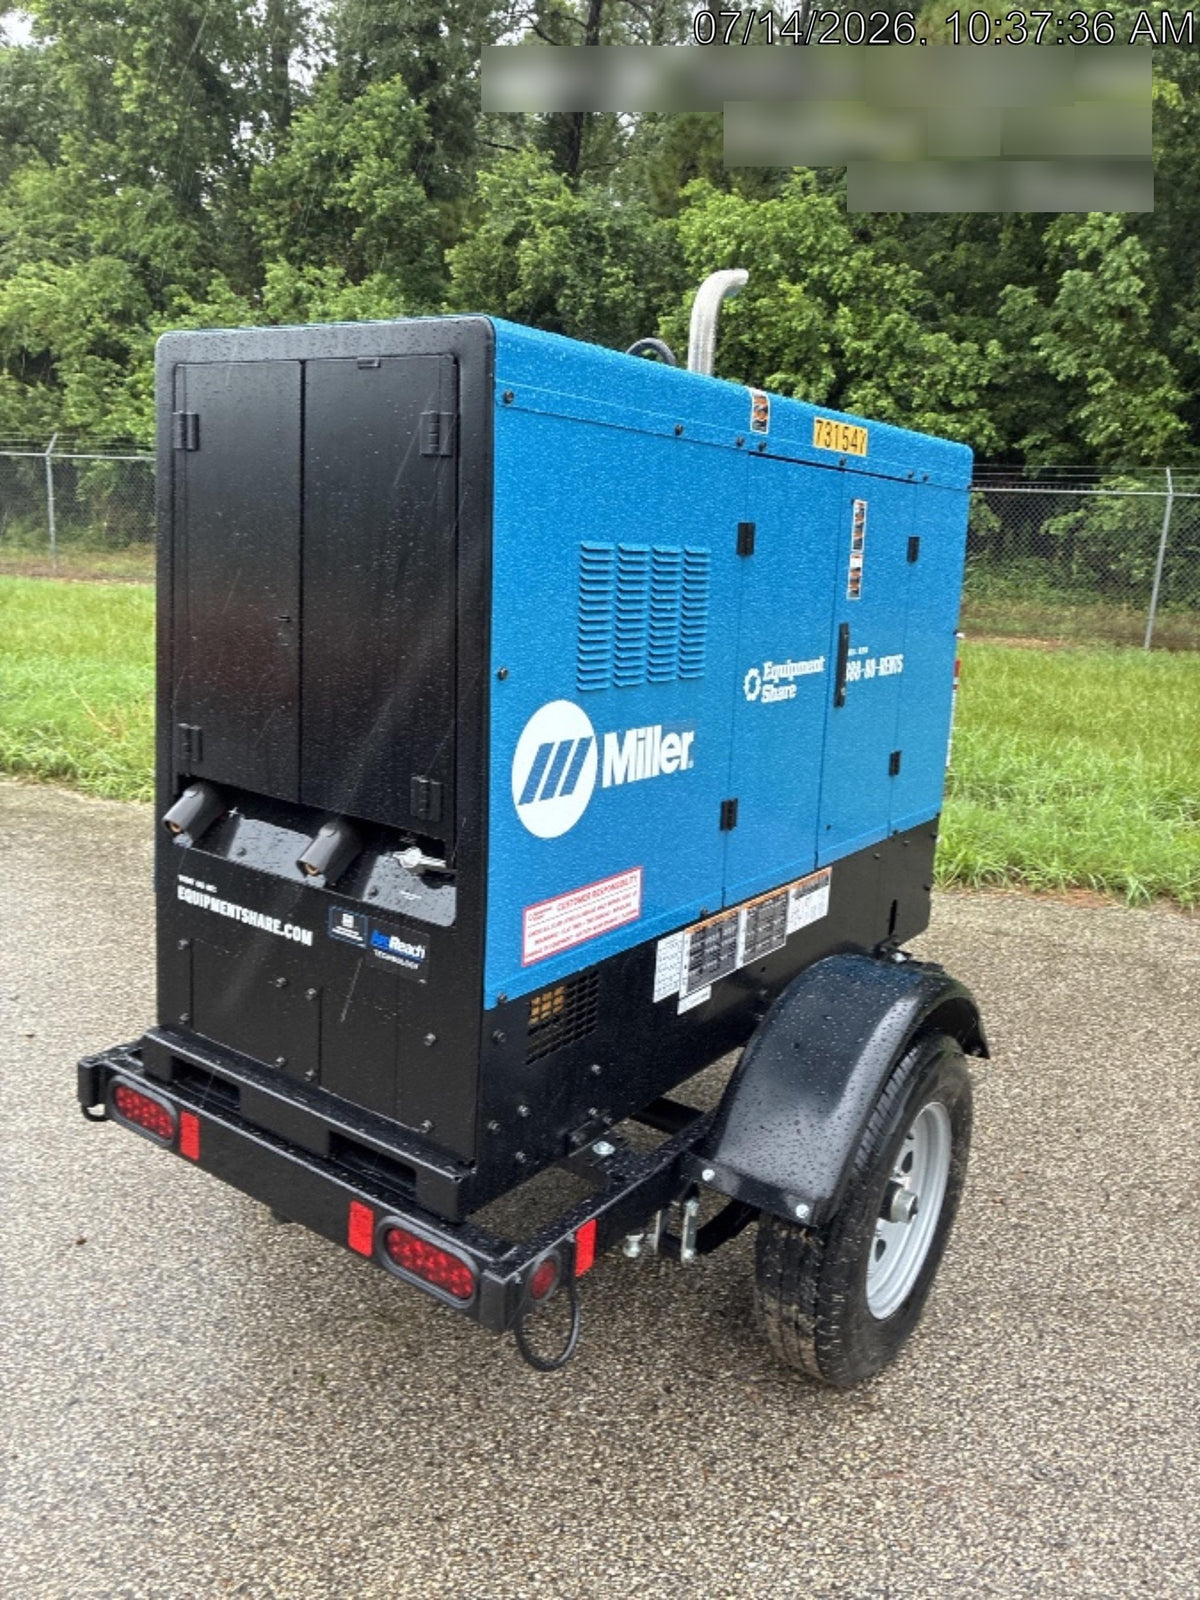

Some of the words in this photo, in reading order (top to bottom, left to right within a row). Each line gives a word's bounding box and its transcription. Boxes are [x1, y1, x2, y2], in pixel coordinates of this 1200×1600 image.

[815, 419, 866, 454] 731547
[762, 656, 825, 683] Equipment
[761, 684, 798, 703] Share
[602, 725, 694, 788] Miller
[177, 885, 314, 946] EQUIPMENTSHARE.COM
